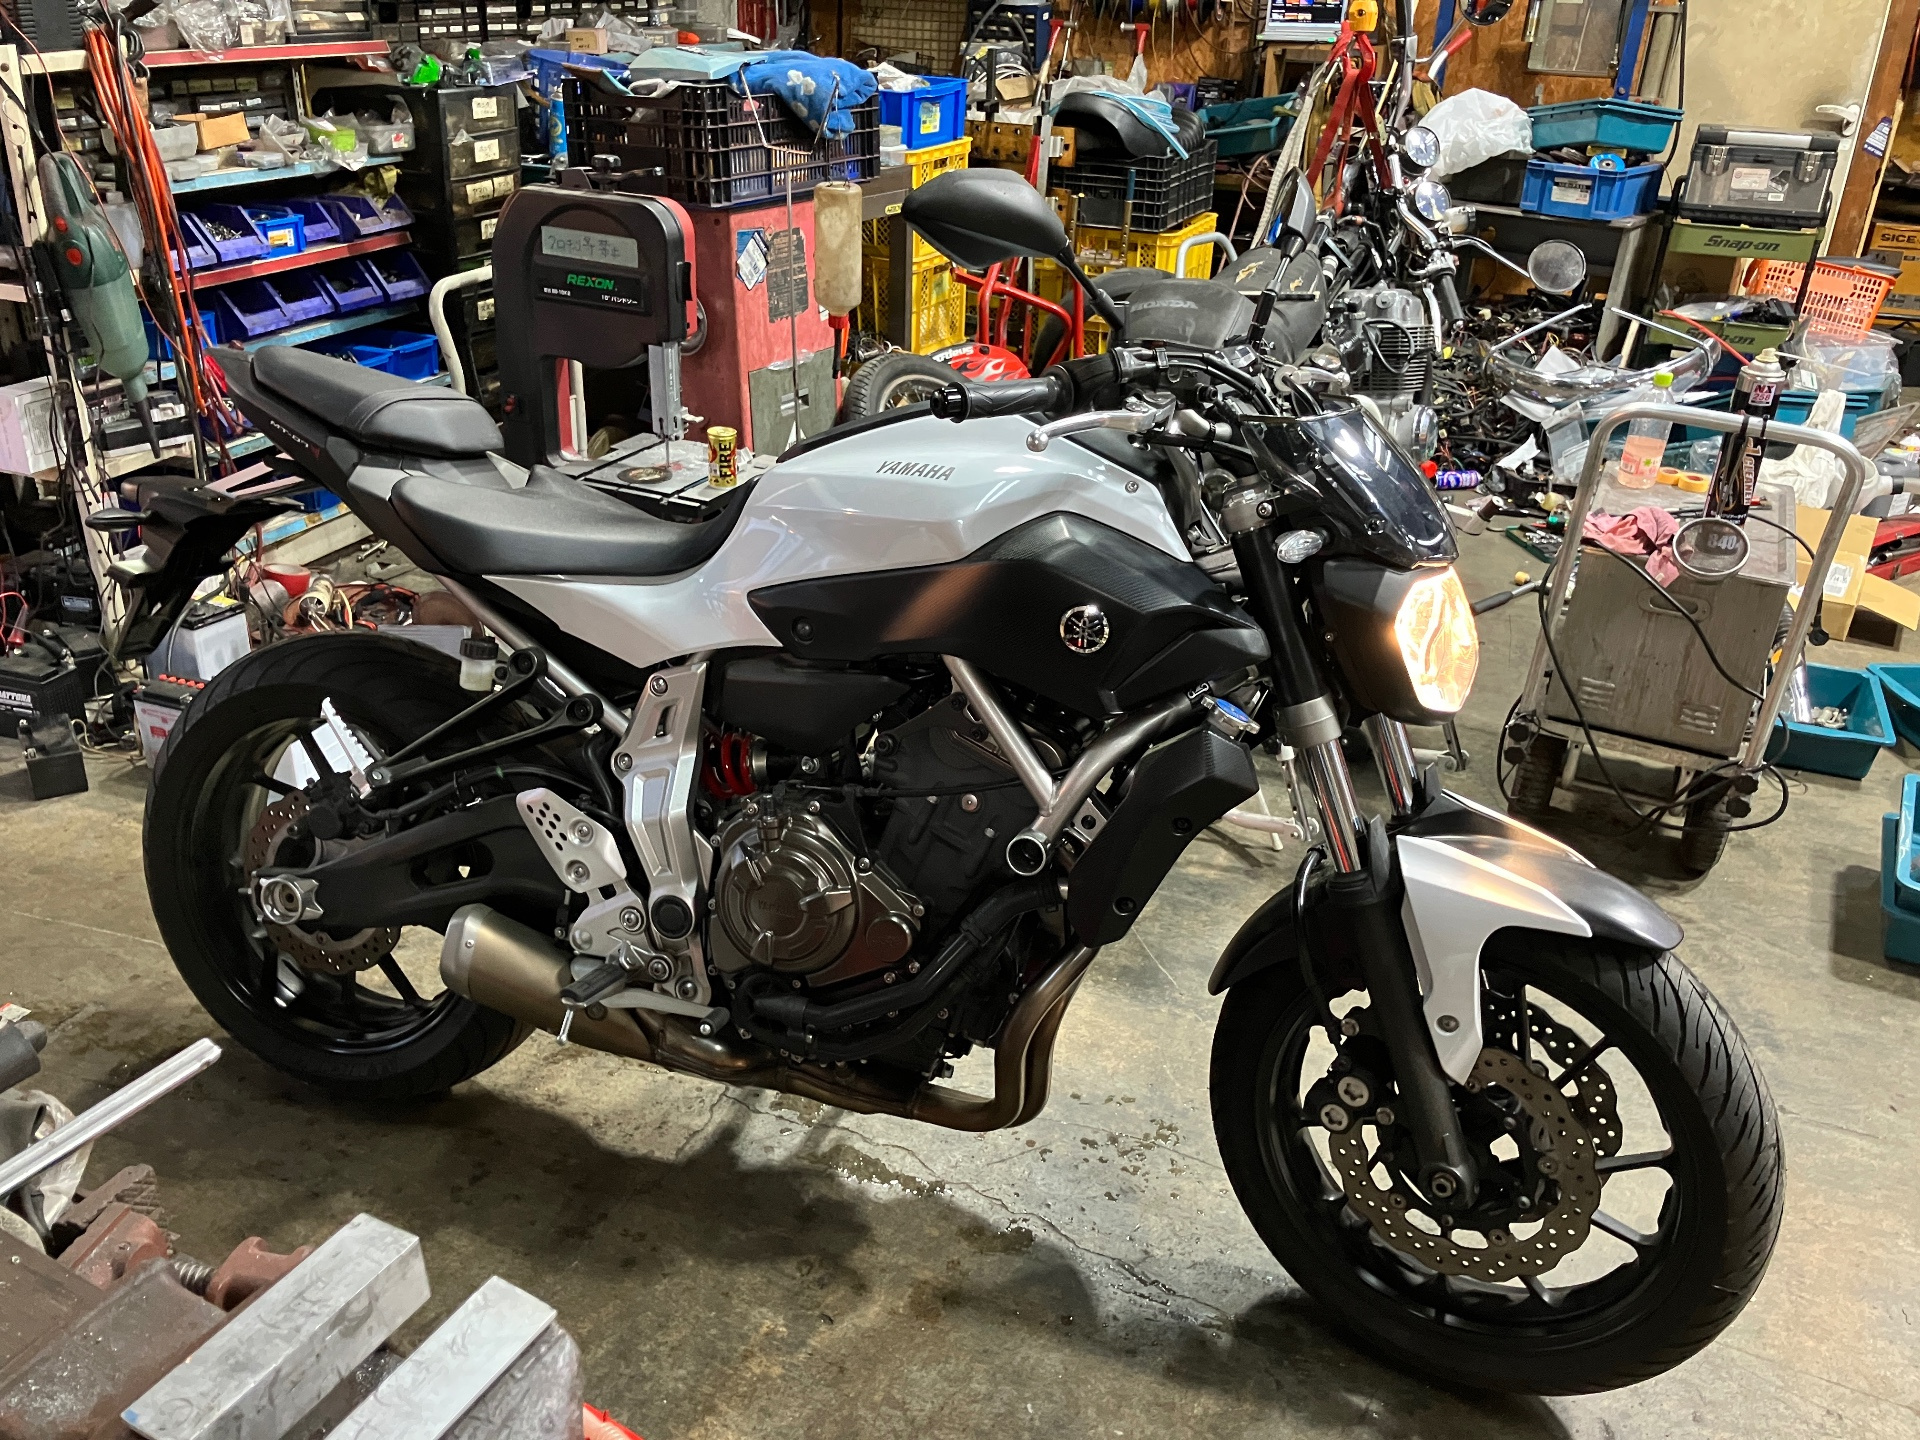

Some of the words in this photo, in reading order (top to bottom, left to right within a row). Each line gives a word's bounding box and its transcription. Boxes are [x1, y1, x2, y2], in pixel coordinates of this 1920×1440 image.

[1703, 235, 1781, 252] Snap-on
[566, 273, 615, 291] REXON
[611, 296, 638, 305] バンドソー
[270, 420, 309, 448] MT-07
[719, 442, 732, 478] FIRE
[875, 460, 956, 481] YAMAHA
[1742, 455, 1755, 506] CLEANER
[0, 691, 31, 703] AYTONA
